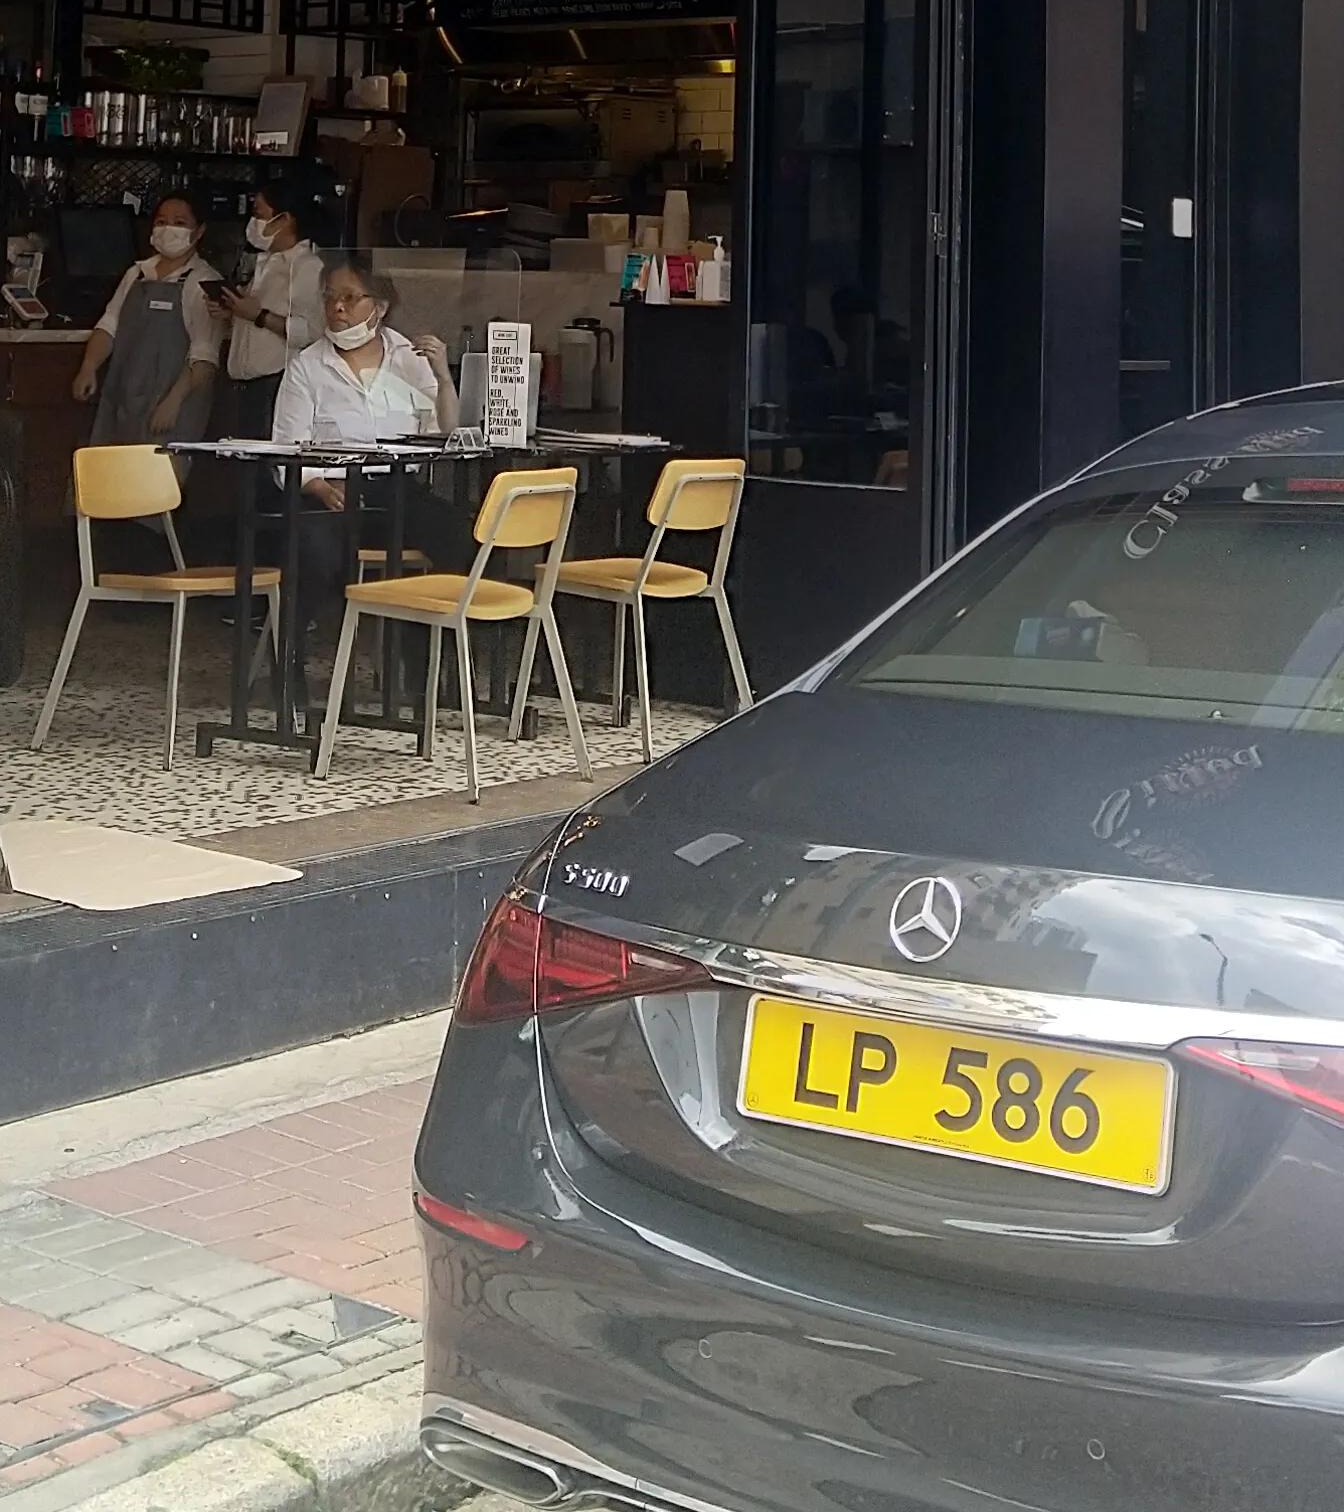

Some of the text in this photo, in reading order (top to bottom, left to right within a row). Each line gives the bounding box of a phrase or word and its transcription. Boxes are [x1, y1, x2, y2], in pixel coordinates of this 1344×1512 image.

[491, 346, 511, 356] GREAT
[491, 356, 524, 366] SELECTION
[491, 365, 521, 375] OF WINES
[490, 374, 525, 385] TO UNWIND
[506, 408, 519, 418] AND
[488, 417, 522, 427] SPARKLING
[488, 427, 509, 436] WINES
[561, 862, 630, 898] S500
[792, 1020, 1102, 1156] LP 586
